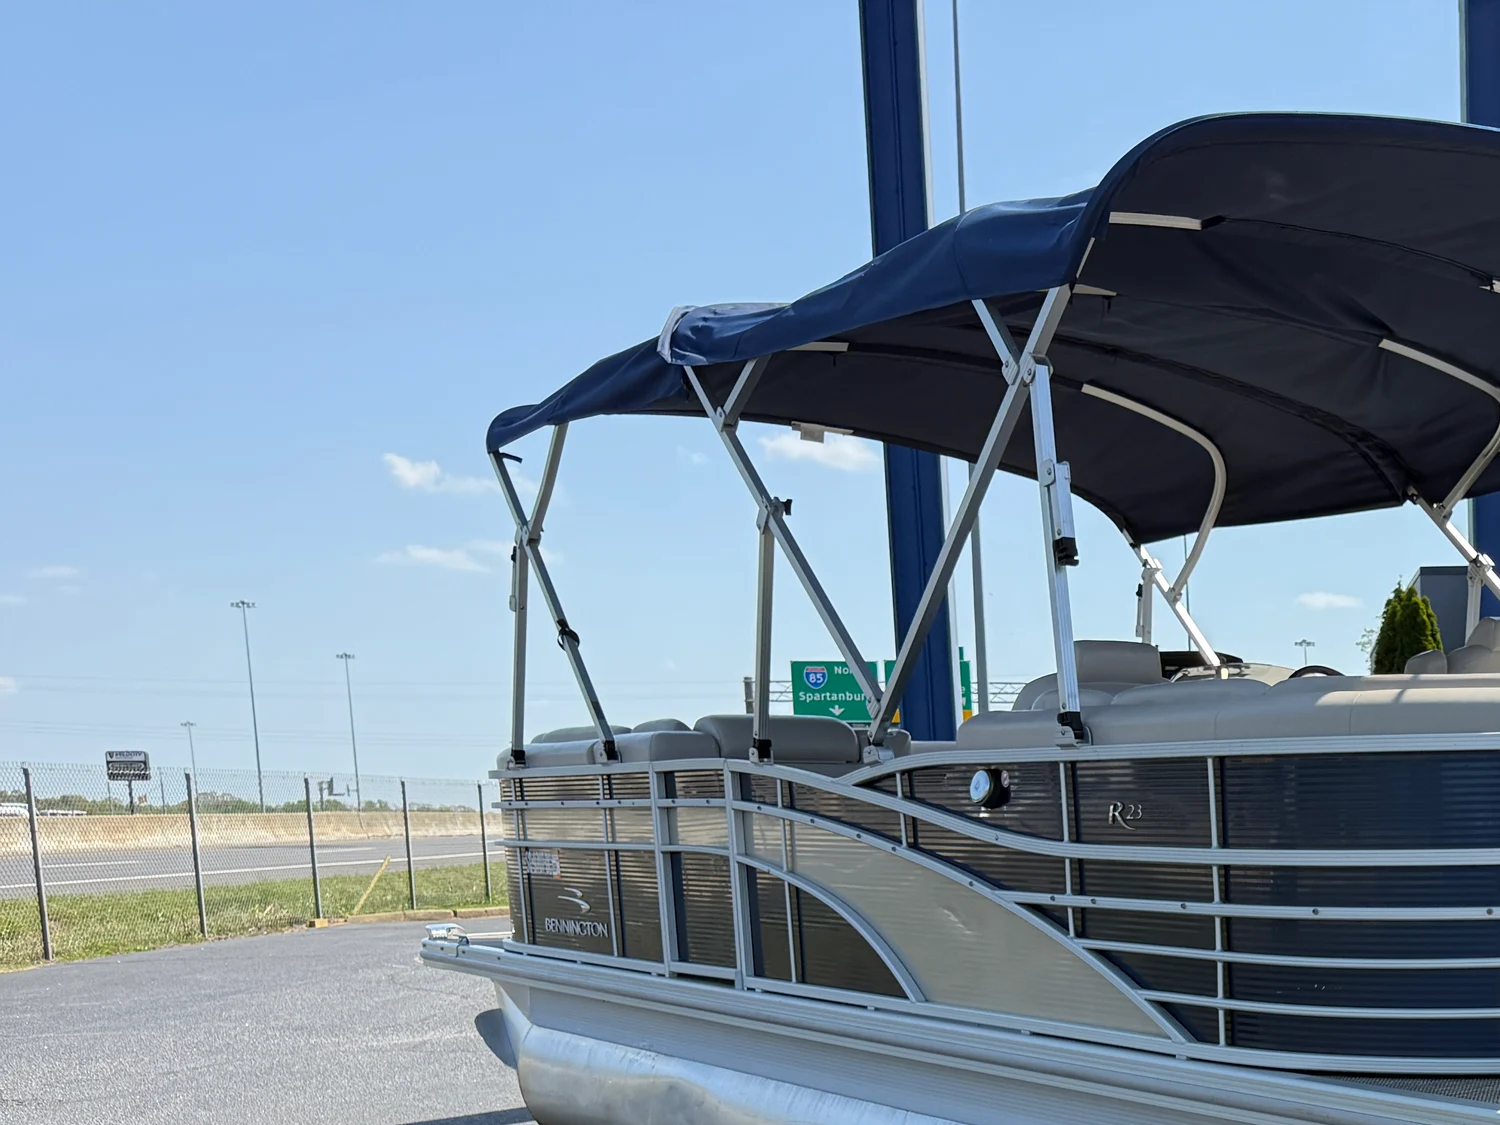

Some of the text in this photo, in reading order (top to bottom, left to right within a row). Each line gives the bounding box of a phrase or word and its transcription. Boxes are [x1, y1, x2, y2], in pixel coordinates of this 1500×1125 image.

[809, 673, 824, 685] 85
[799, 691, 868, 704] Spartanbur
[545, 918, 609, 937] BENNINGTON
